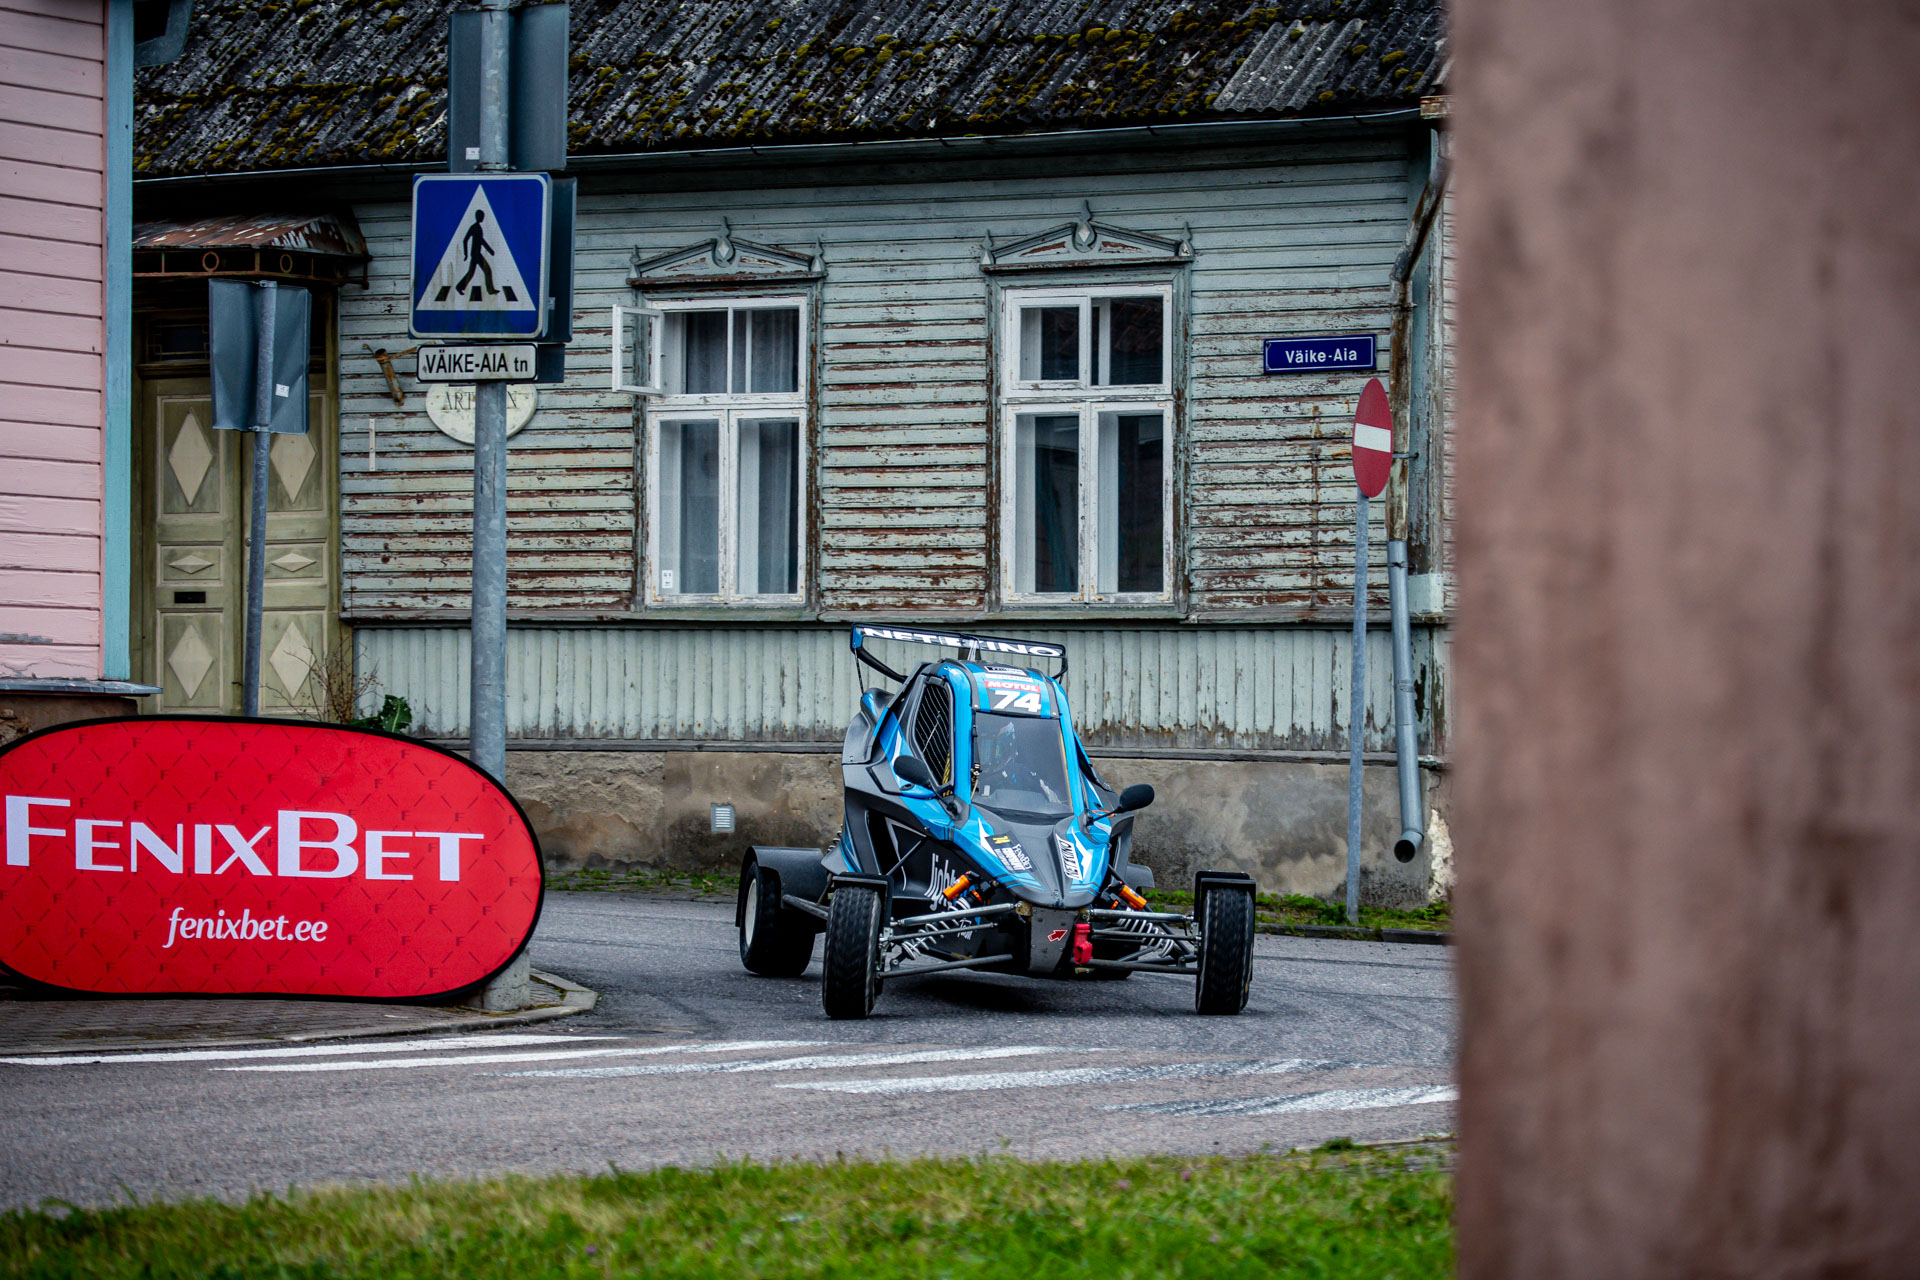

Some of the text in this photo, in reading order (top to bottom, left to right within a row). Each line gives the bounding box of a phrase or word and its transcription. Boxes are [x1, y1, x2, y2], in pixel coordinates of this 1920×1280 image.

[425, 349, 528, 373] VÄIKE-AIA tn
[1285, 348, 1357, 363] Väike-Aia
[988, 680, 1038, 692] MOTUL
[993, 690, 1041, 712] 74
[162, 907, 328, 948] fenixbet.ee
